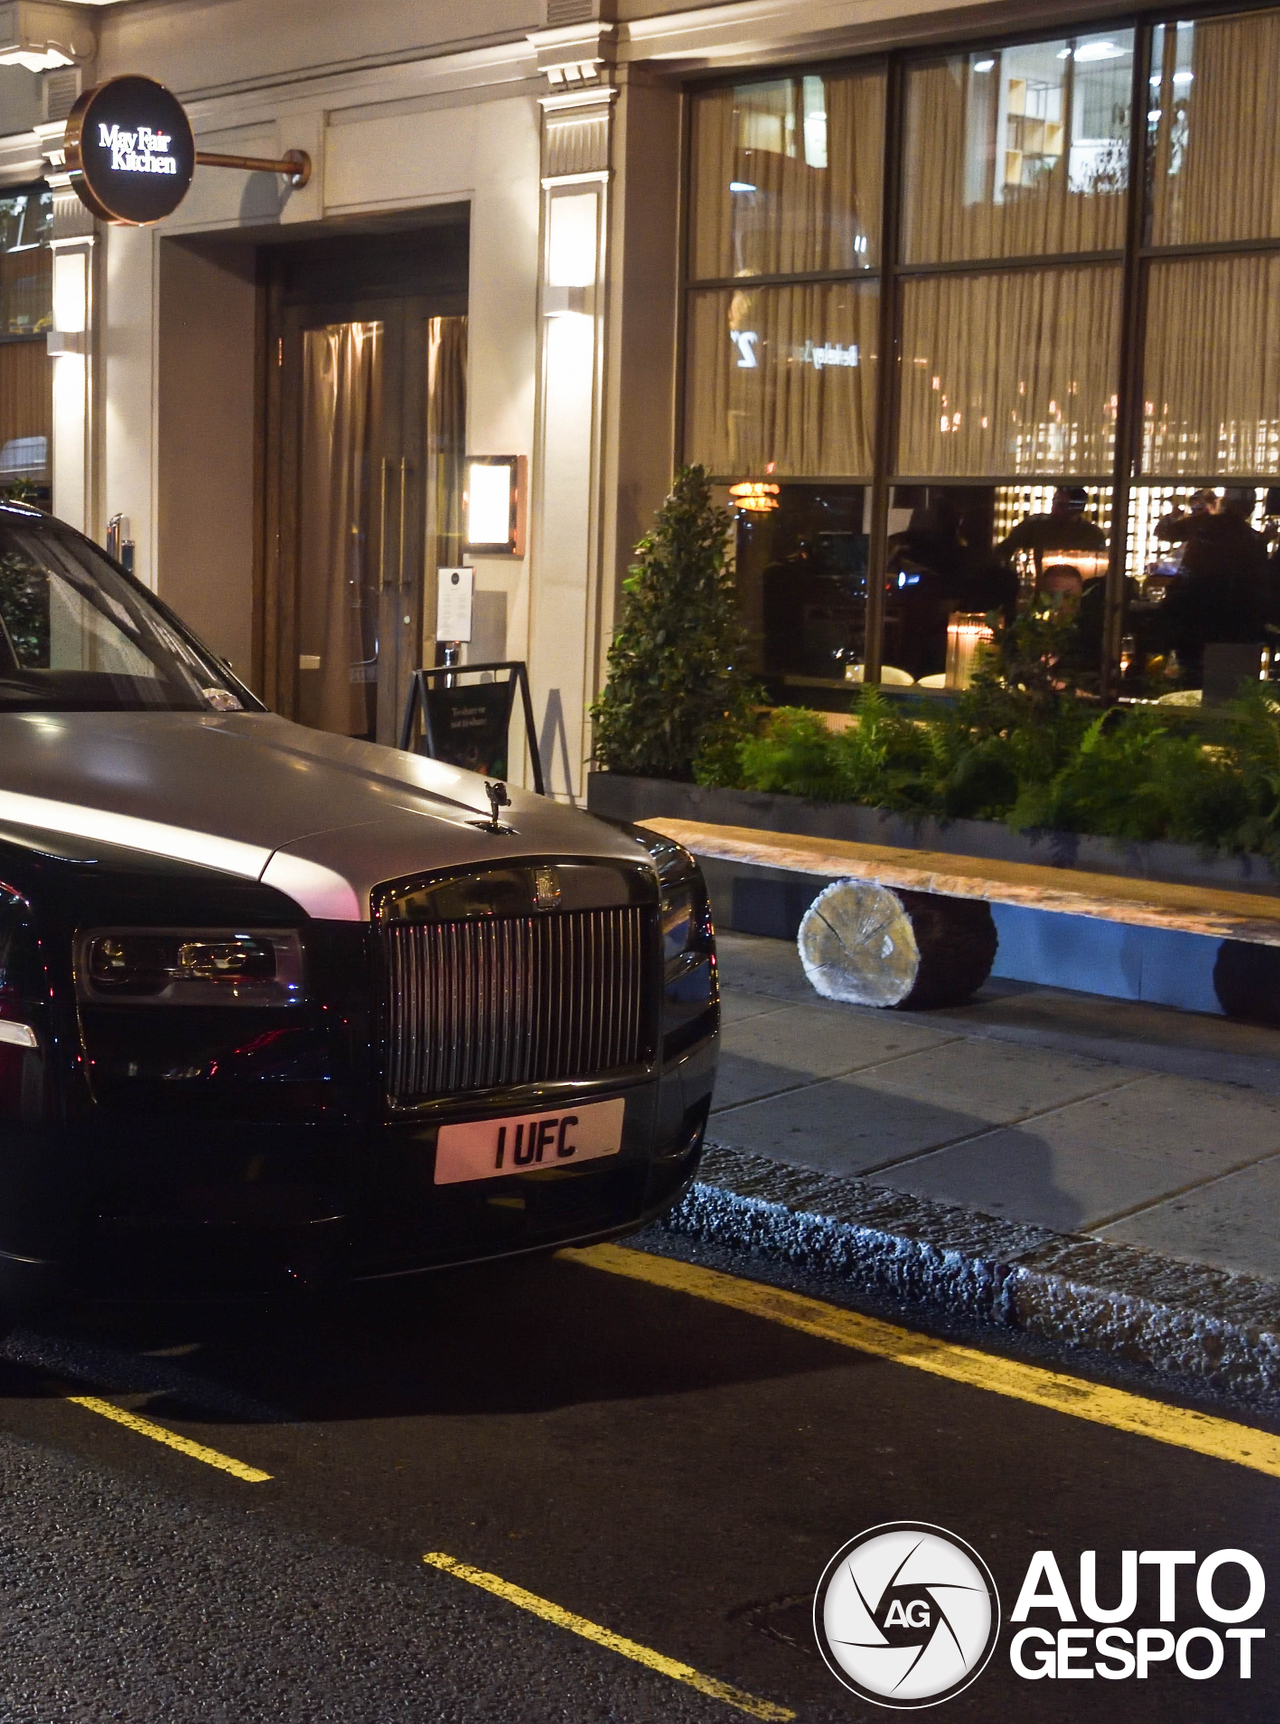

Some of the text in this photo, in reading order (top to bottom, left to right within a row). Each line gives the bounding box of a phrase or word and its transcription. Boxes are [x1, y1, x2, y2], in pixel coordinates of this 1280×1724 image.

[98, 123, 171, 152] May Fair
[111, 148, 177, 174] Kitchen
[514, 1115, 579, 1166] UFC
